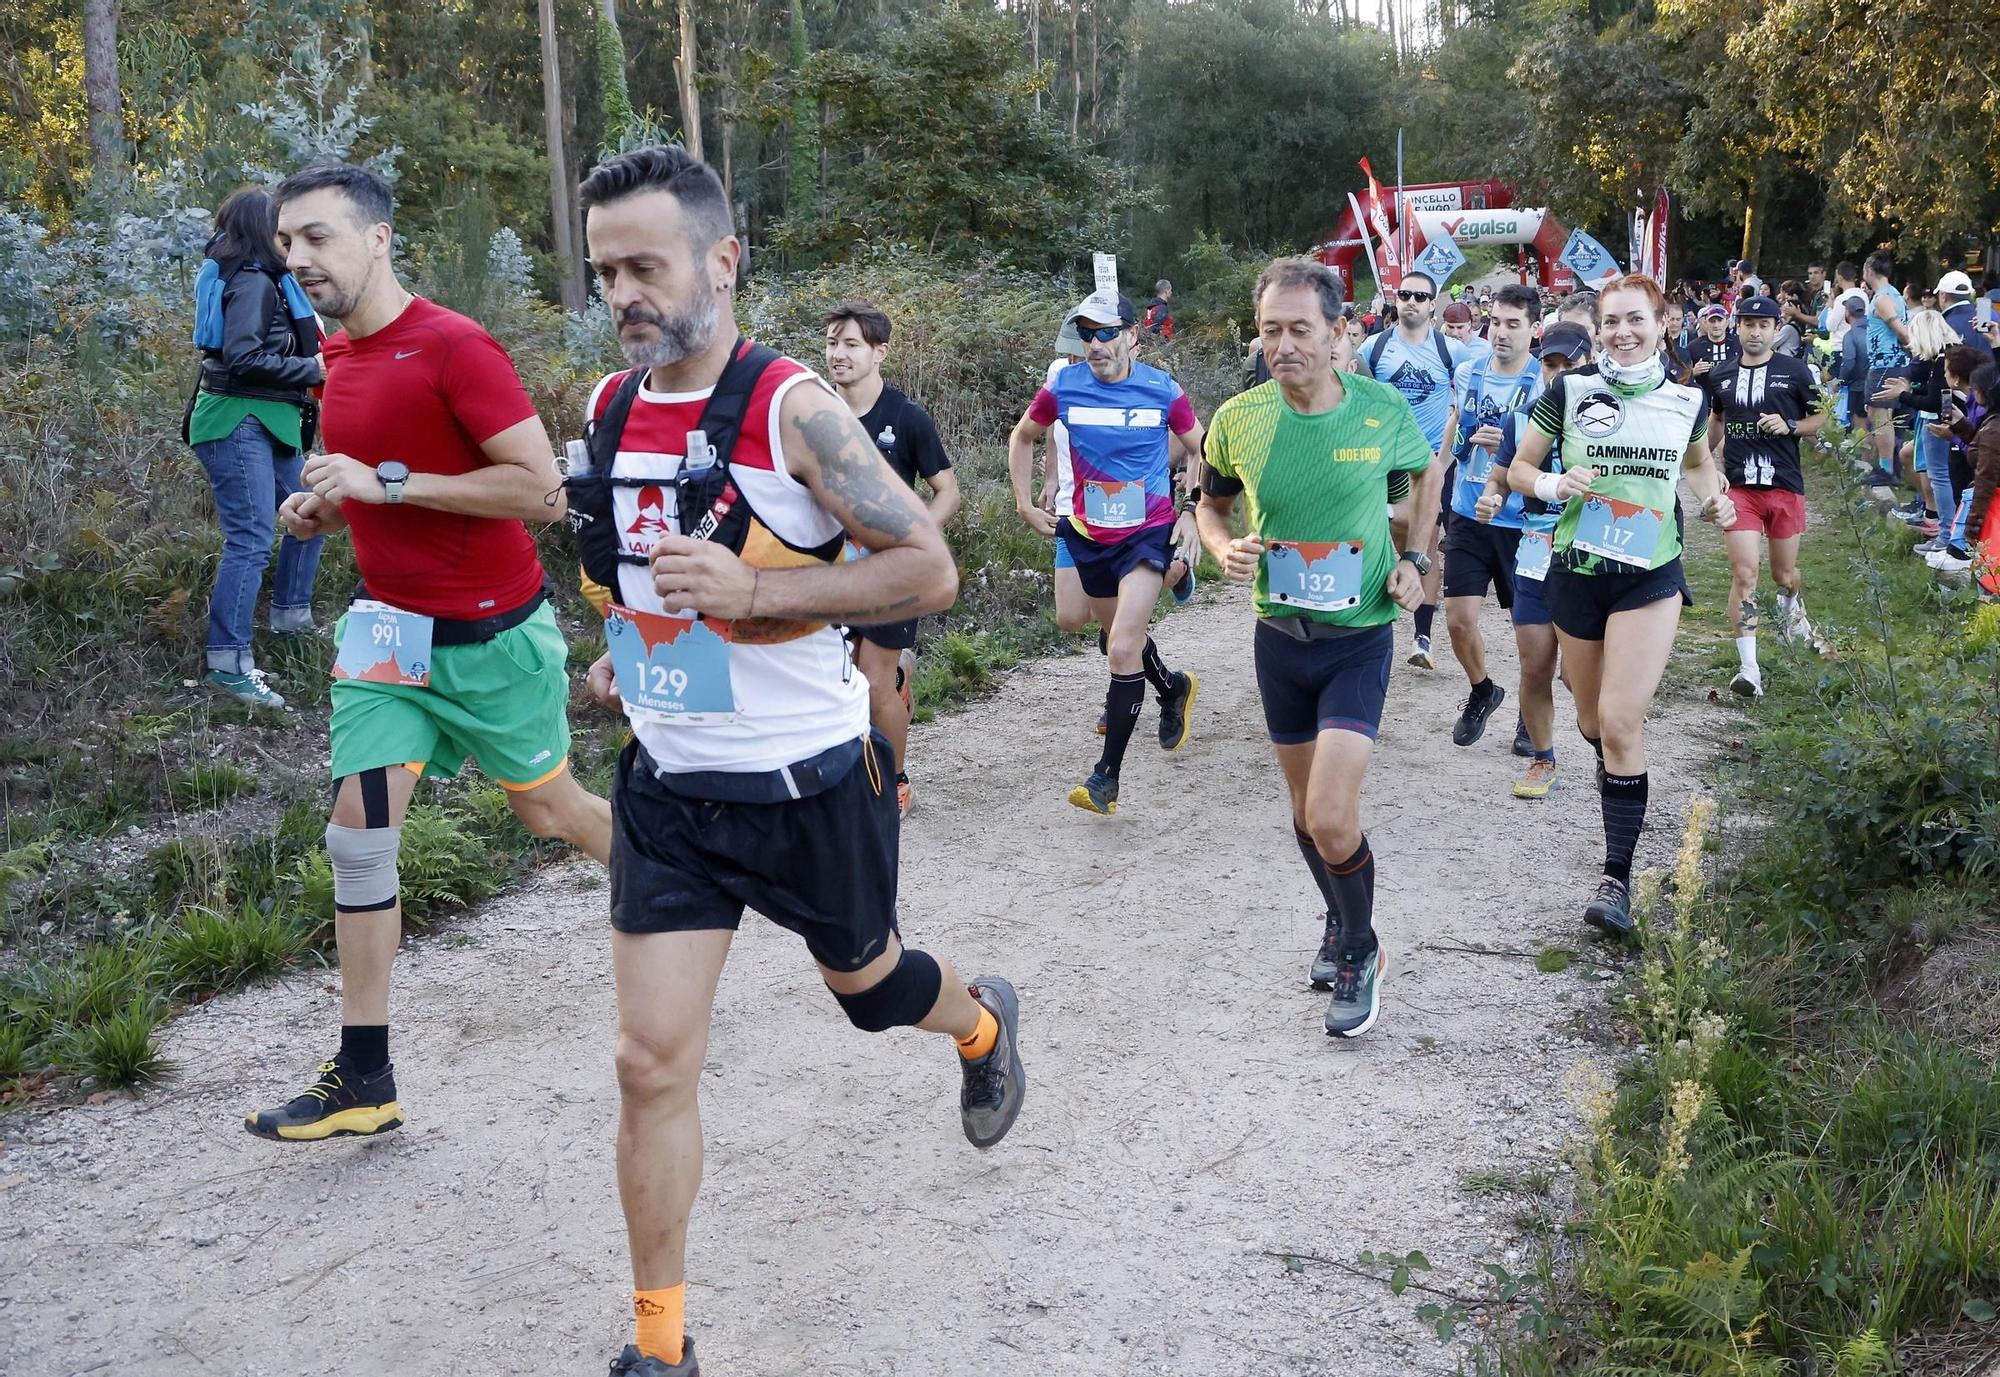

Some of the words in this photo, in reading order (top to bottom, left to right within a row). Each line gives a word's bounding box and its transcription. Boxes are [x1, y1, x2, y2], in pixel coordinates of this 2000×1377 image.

[1402, 193, 1456, 205] NCELLO
[1441, 216, 1518, 240] Vegalsa
[1586, 444, 1678, 462] CAMINHANTES
[1101, 502, 1127, 516] 142
[1602, 525, 1634, 546] 117
[1298, 572, 1336, 593] 132
[371, 623, 402, 647] 166
[636, 662, 688, 698] 129
[638, 692, 685, 711] Meneses
[1606, 777, 1641, 786] CRIVIT
